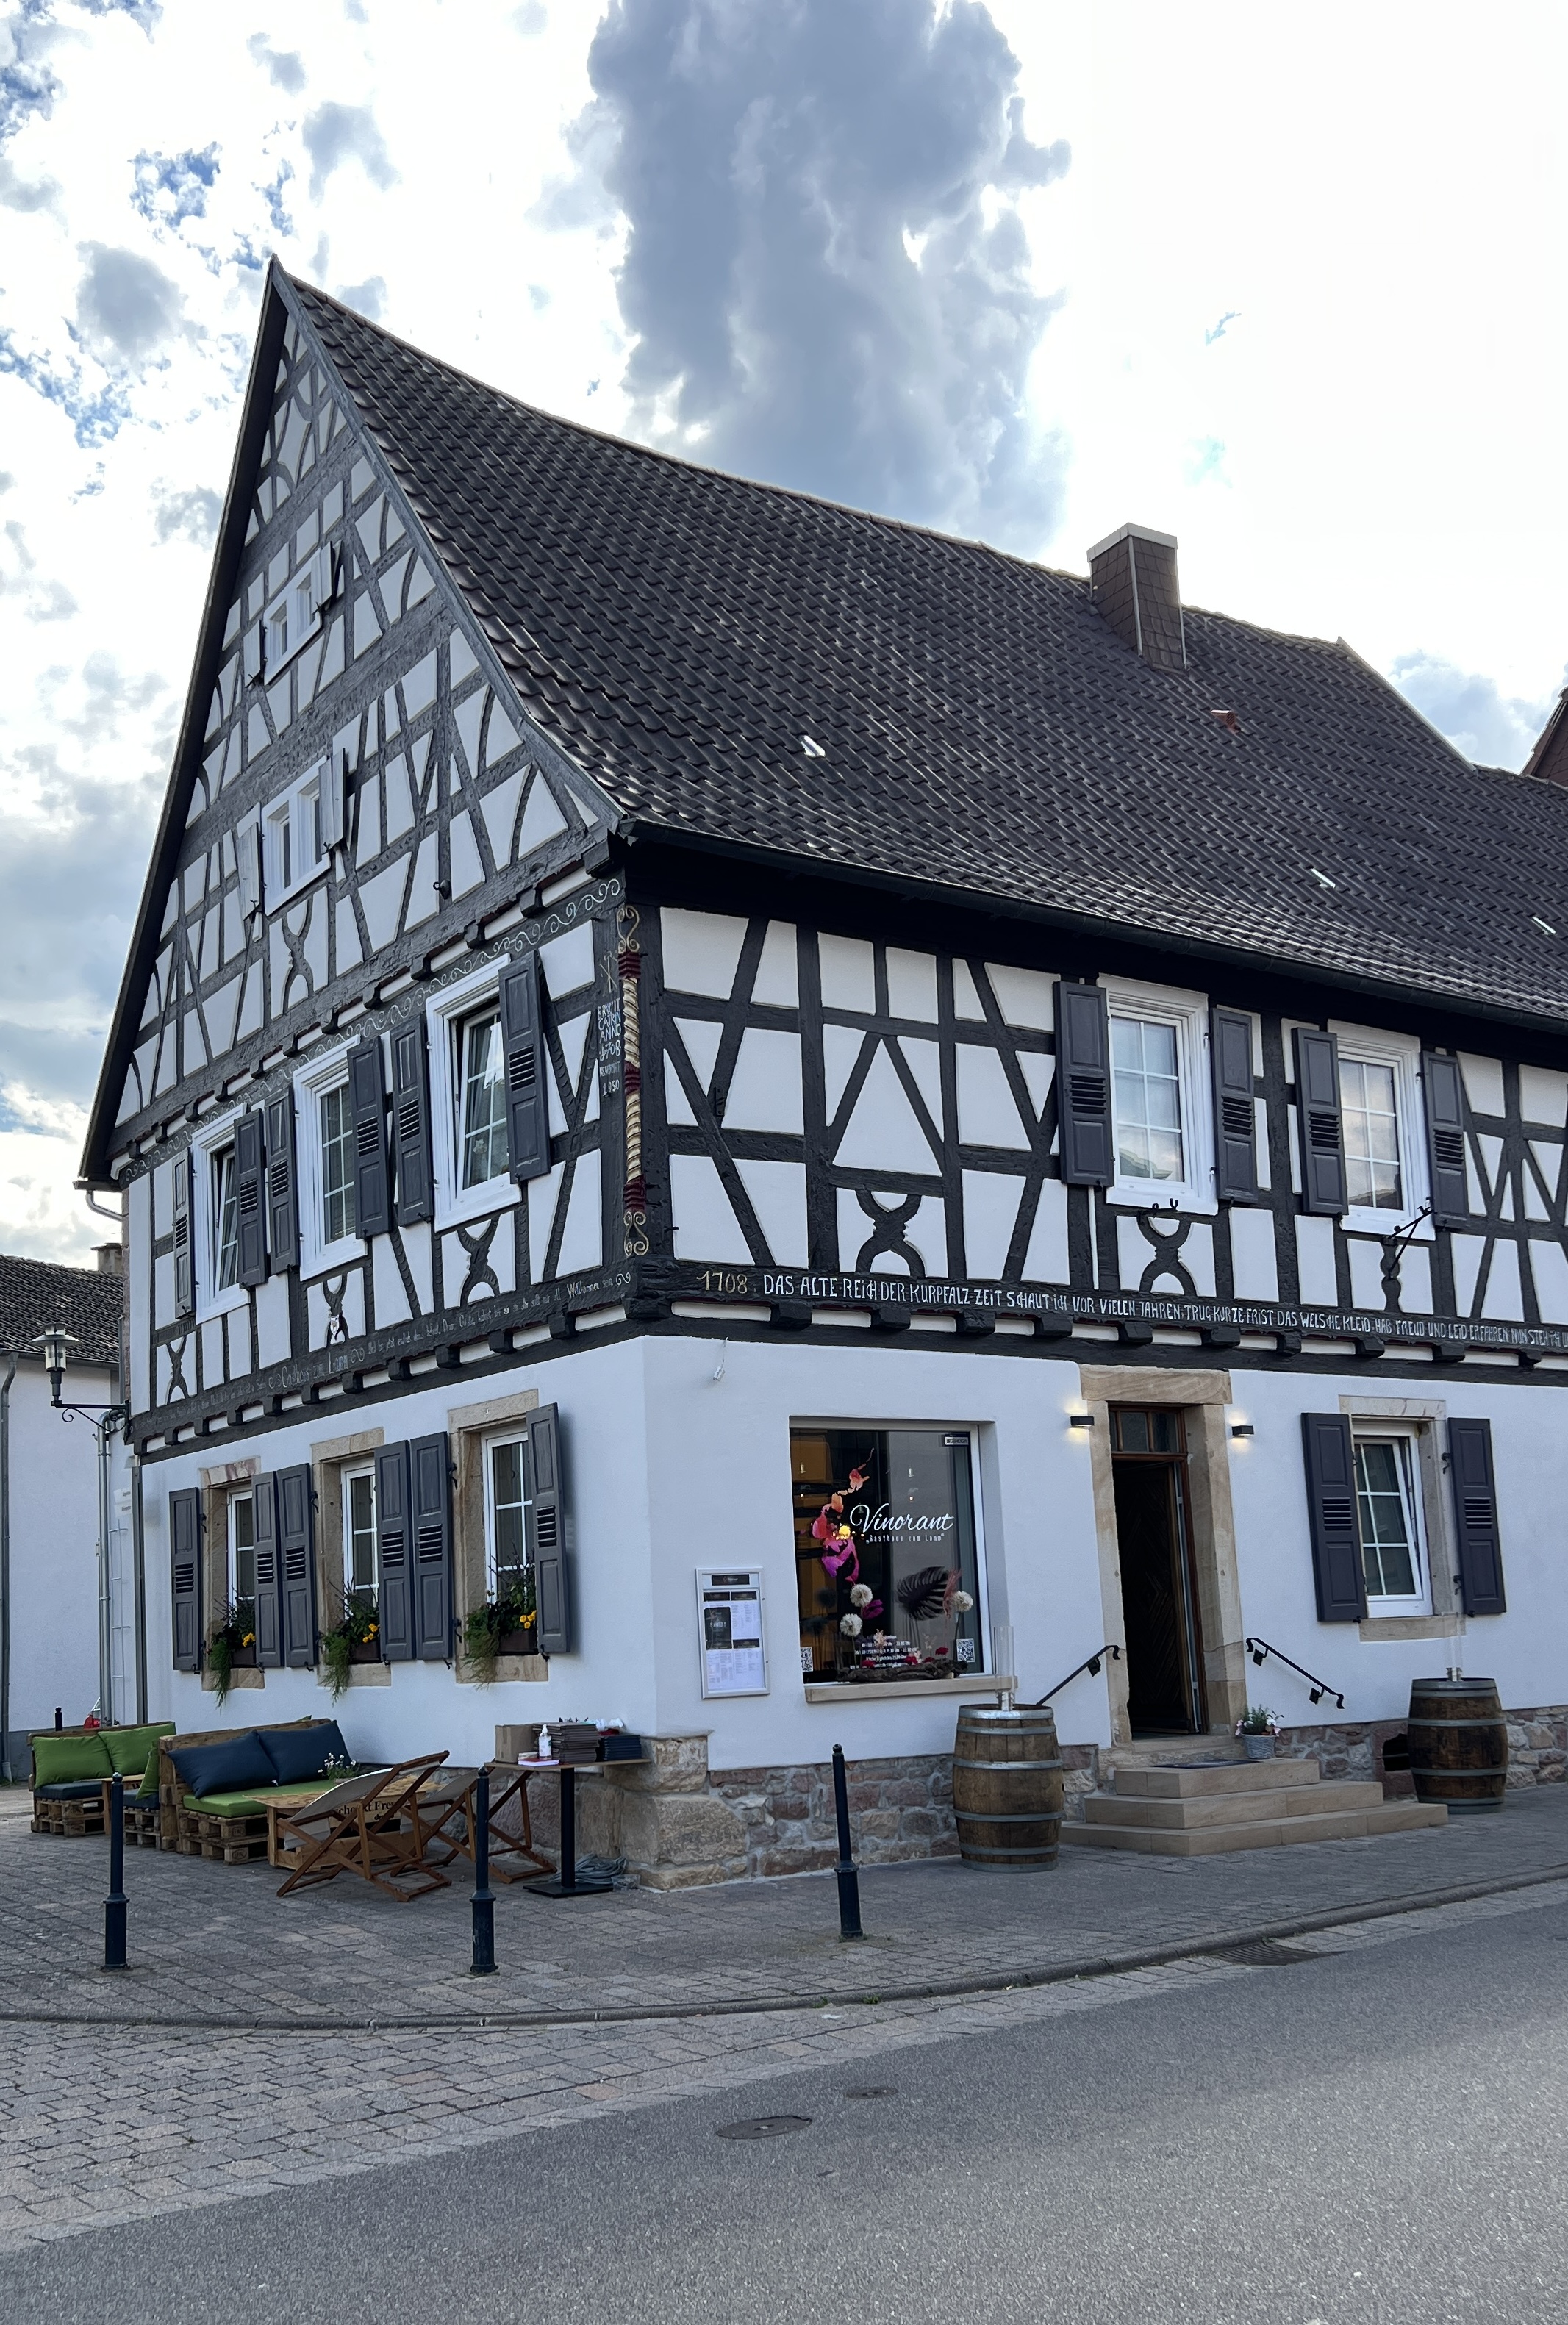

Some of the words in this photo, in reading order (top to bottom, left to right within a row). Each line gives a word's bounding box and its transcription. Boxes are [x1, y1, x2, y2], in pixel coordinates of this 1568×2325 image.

[599, 1023, 622, 1044] ANNO
[696, 1270, 748, 1294] 1708
[763, 1274, 795, 1295] DAS
[800, 1276, 838, 1297] ALTE
[881, 1281, 906, 1302] DER
[1072, 1296, 1095, 1314] VOR
[1184, 1305, 1211, 1322] TRUG
[1213, 1306, 1244, 1324] KURZE
[1277, 1311, 1297, 1327] DAS
[1374, 1319, 1392, 1334] HAB
[1428, 1322, 1446, 1339] UND
[850, 1502, 954, 1533] Vinorant
